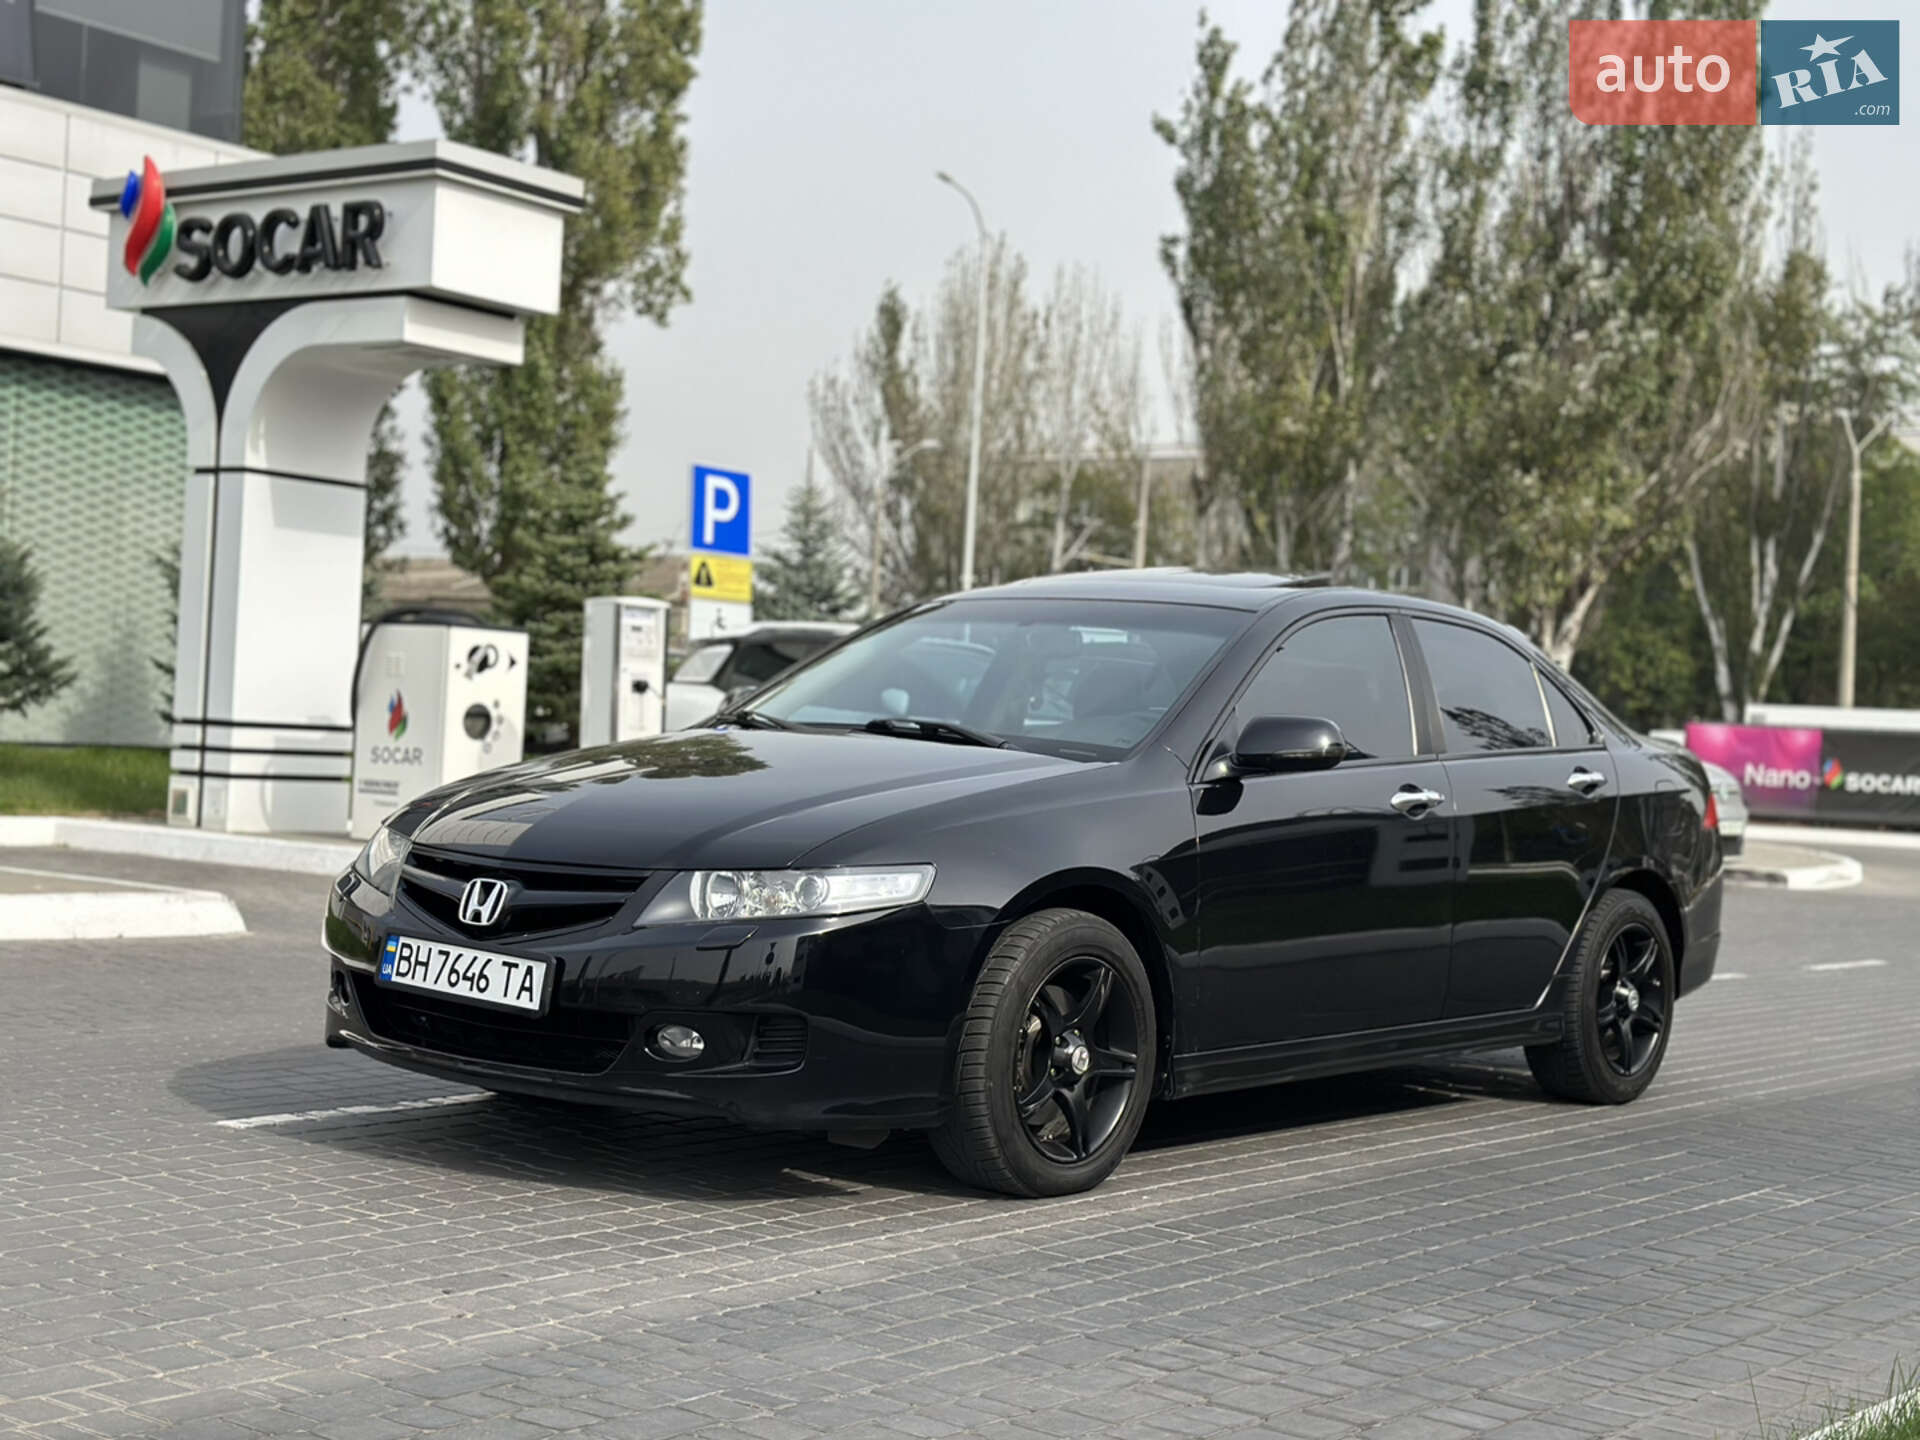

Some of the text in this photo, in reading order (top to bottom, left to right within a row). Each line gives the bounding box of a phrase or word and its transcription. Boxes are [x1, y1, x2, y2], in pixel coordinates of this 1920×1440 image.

[174, 200, 385, 282] SOCAR
[703, 474, 740, 545] P
[370, 746, 424, 766] SOCAR
[1744, 762, 1811, 790] Nano
[382, 963, 392, 975] UA
[502, 961, 535, 1003] TA
